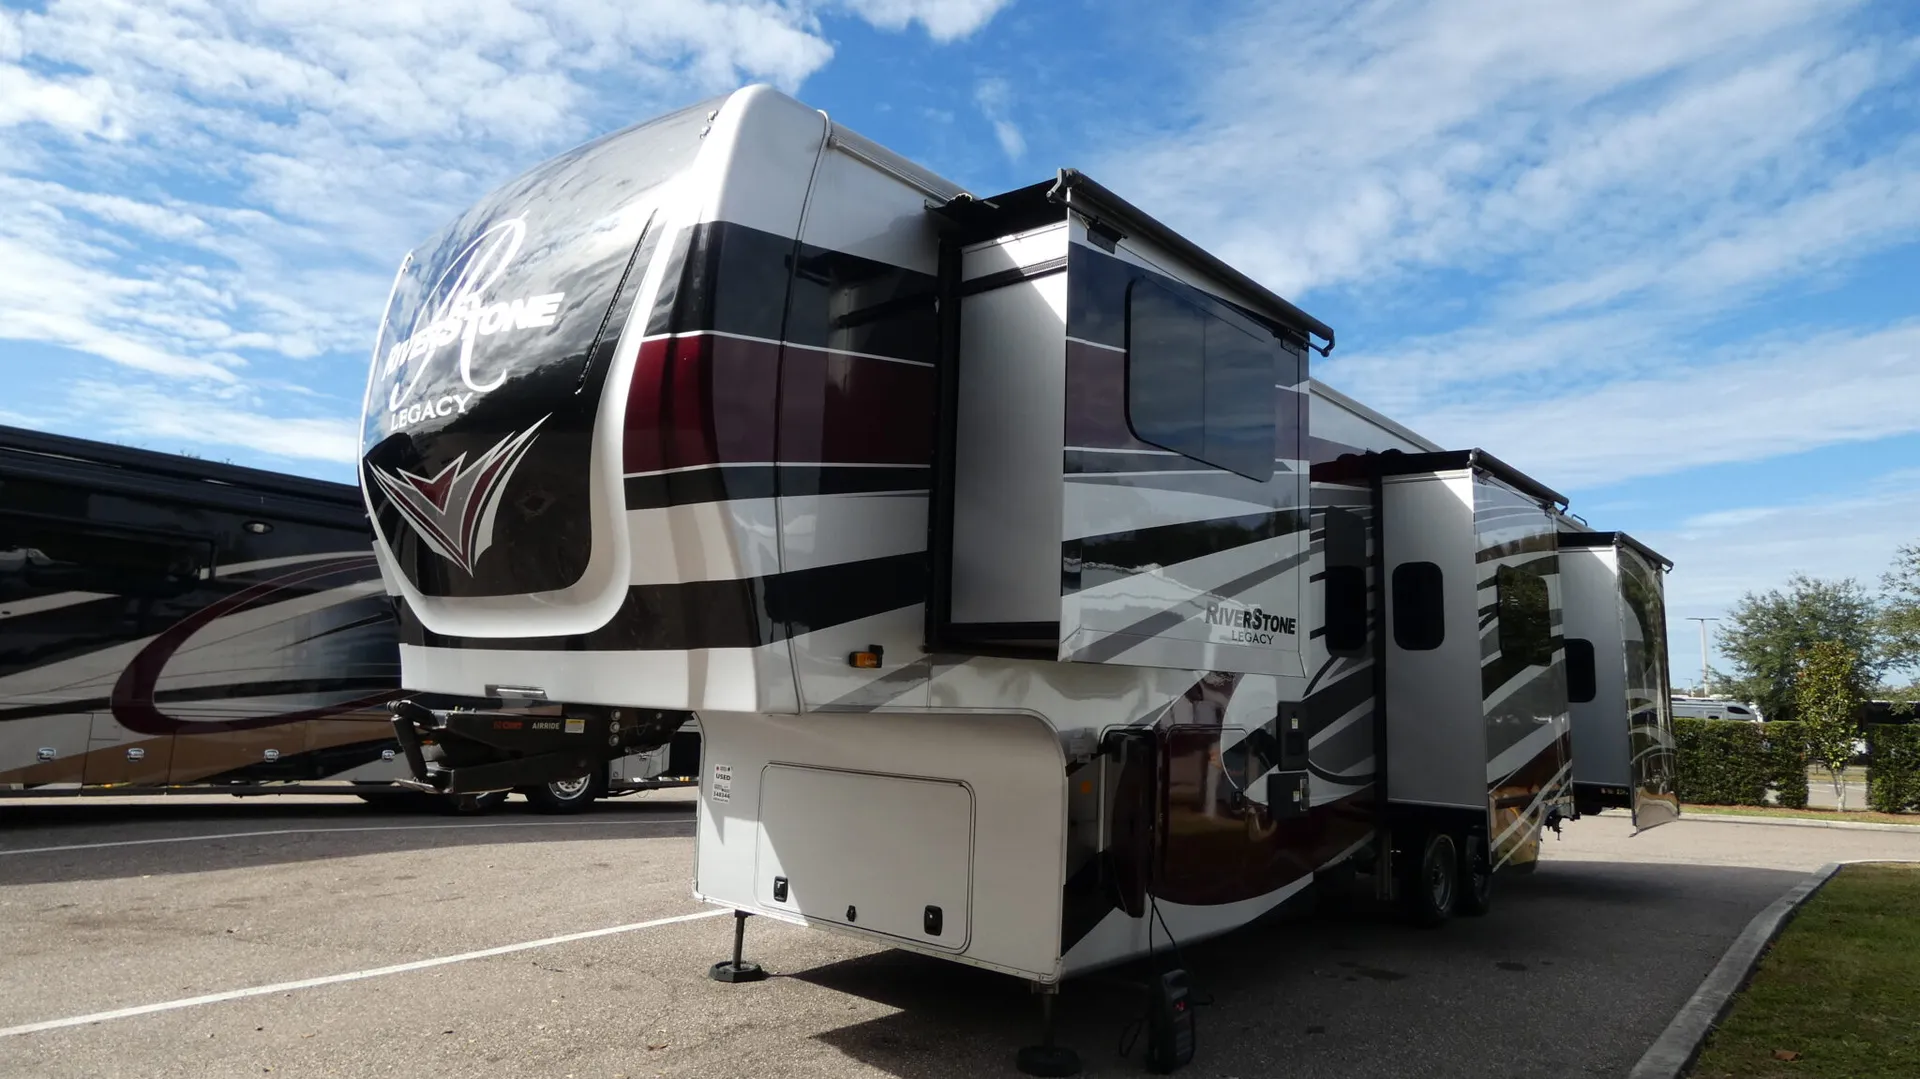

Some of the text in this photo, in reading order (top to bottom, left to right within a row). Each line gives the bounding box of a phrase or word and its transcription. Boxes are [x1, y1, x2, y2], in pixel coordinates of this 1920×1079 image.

[390, 392, 473, 432] LEGACY
[1231, 631, 1274, 645] LEGACY
[716, 773, 731, 781] USED
